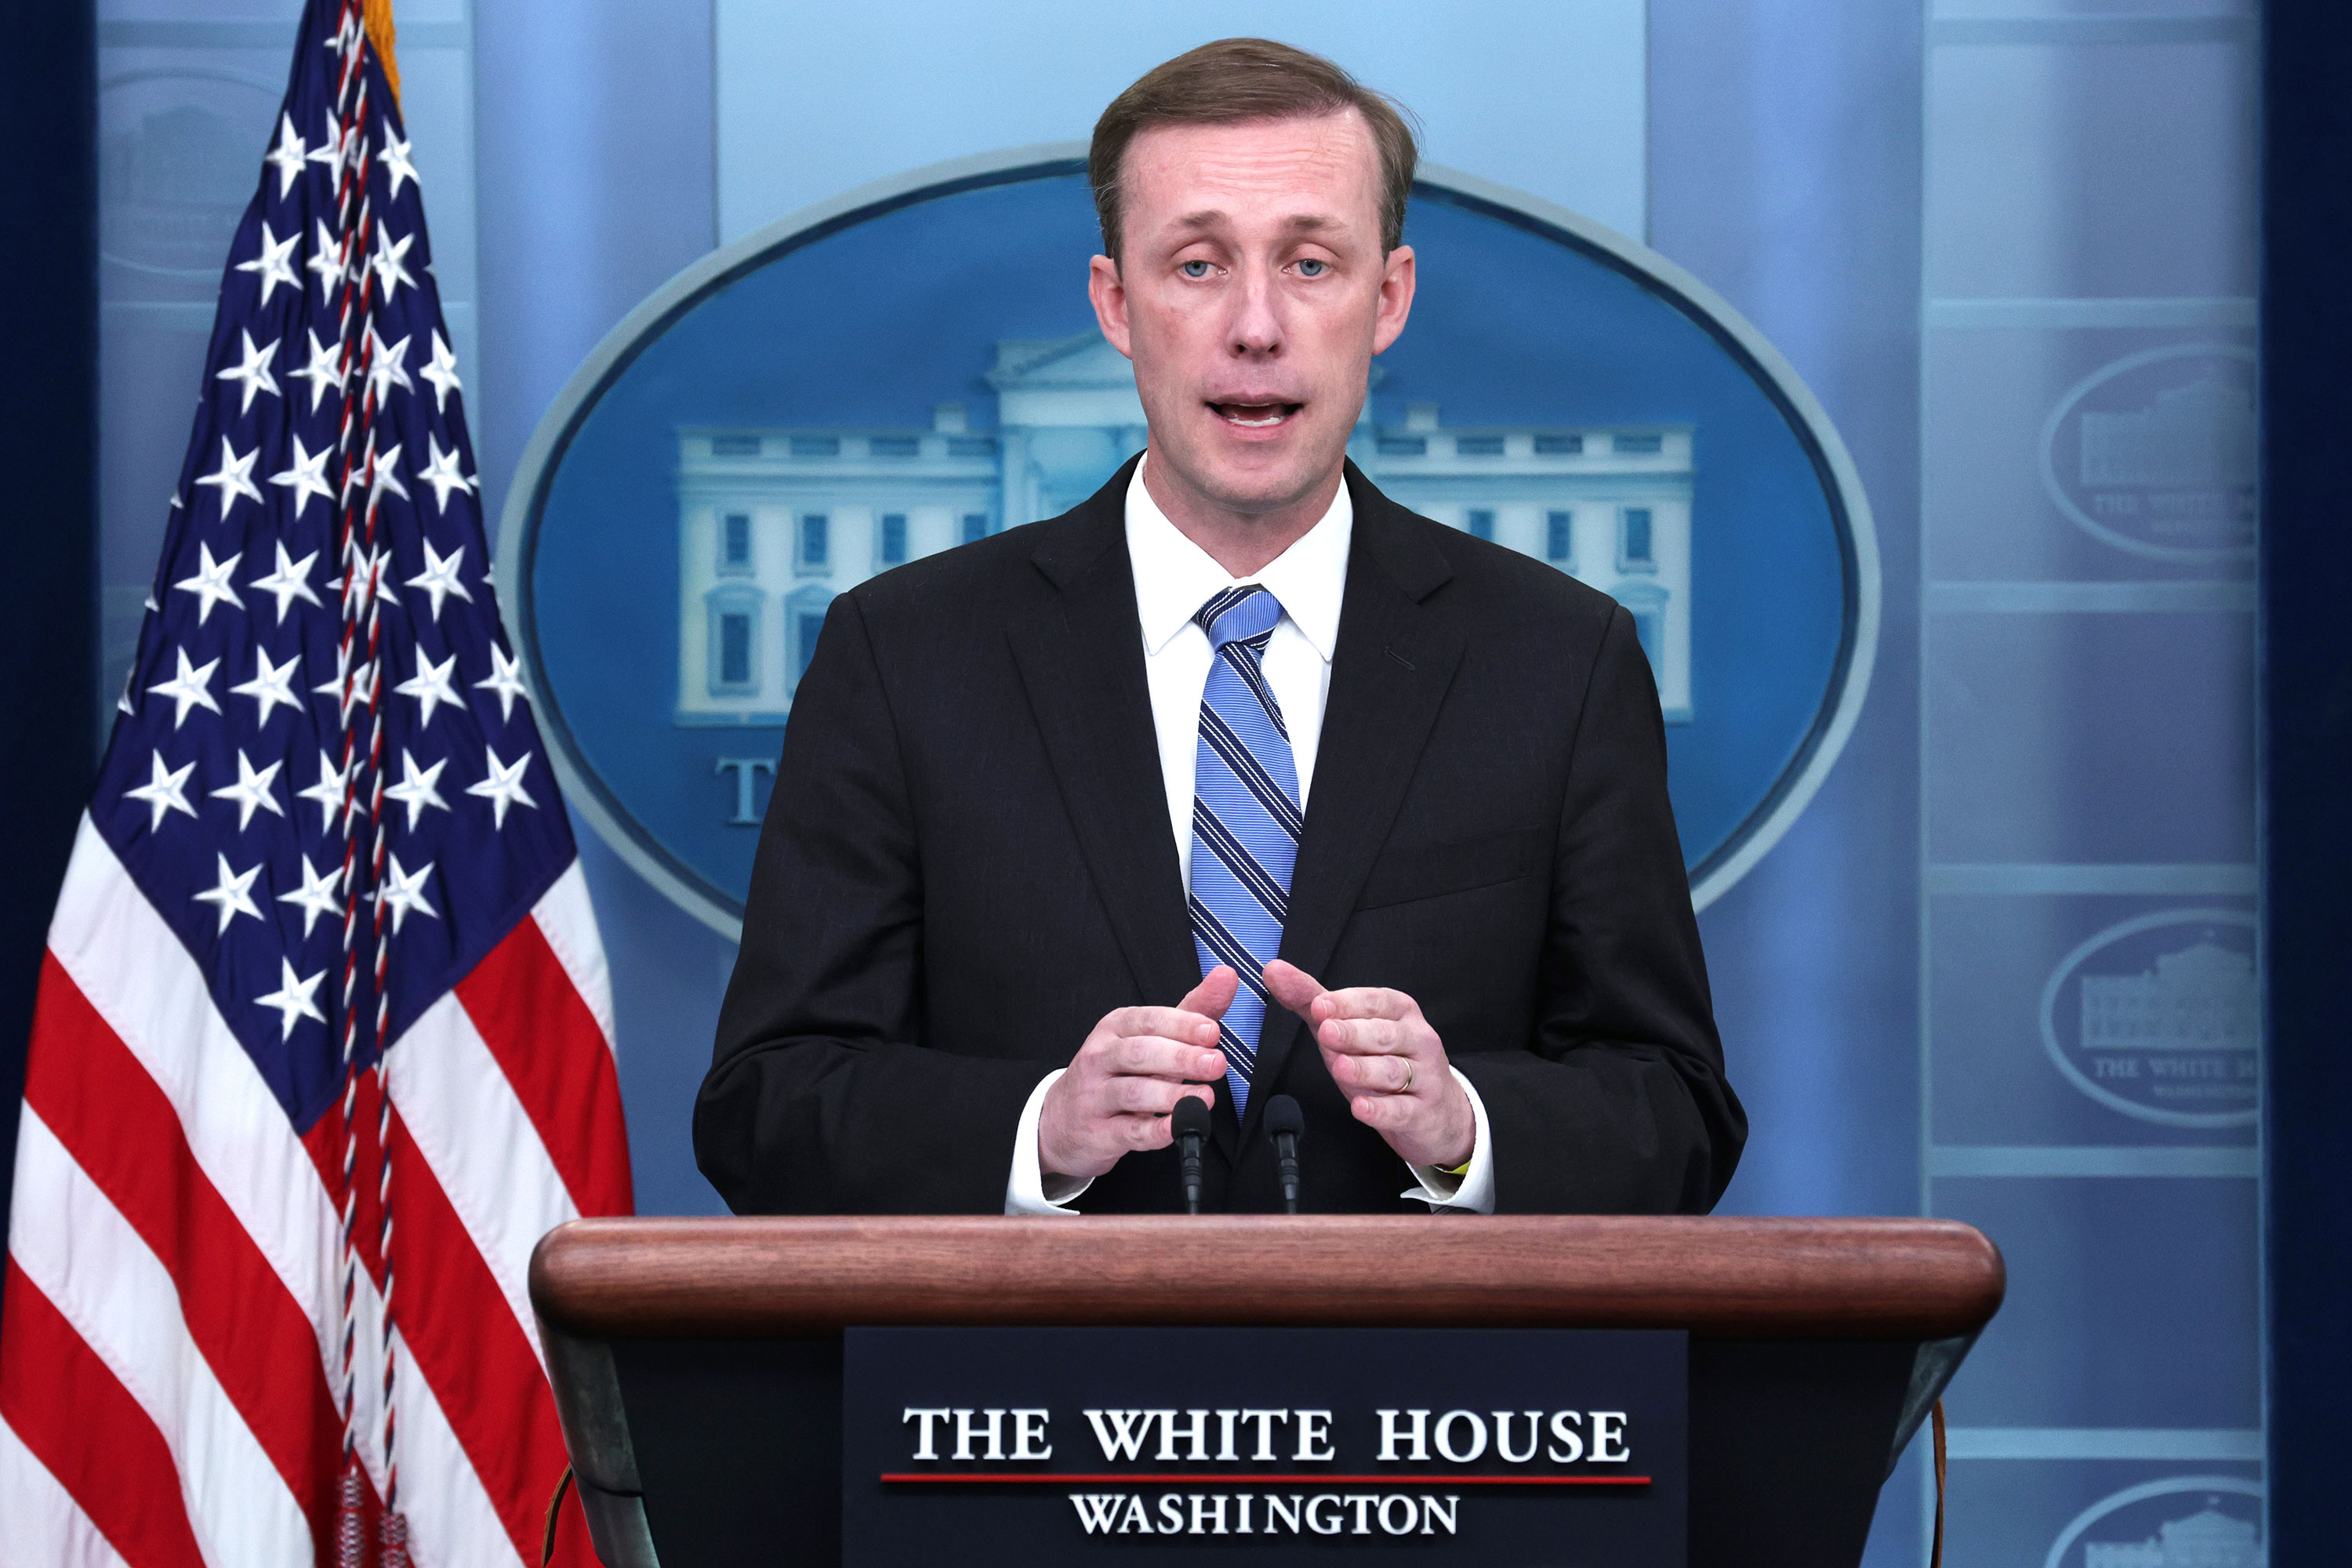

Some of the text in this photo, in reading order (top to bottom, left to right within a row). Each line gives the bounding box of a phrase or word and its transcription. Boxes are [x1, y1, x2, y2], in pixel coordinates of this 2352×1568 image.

[903, 1406, 1631, 1463] THE WHITE HOUSE
[1069, 1494, 1461, 1536] WASHINGTON
